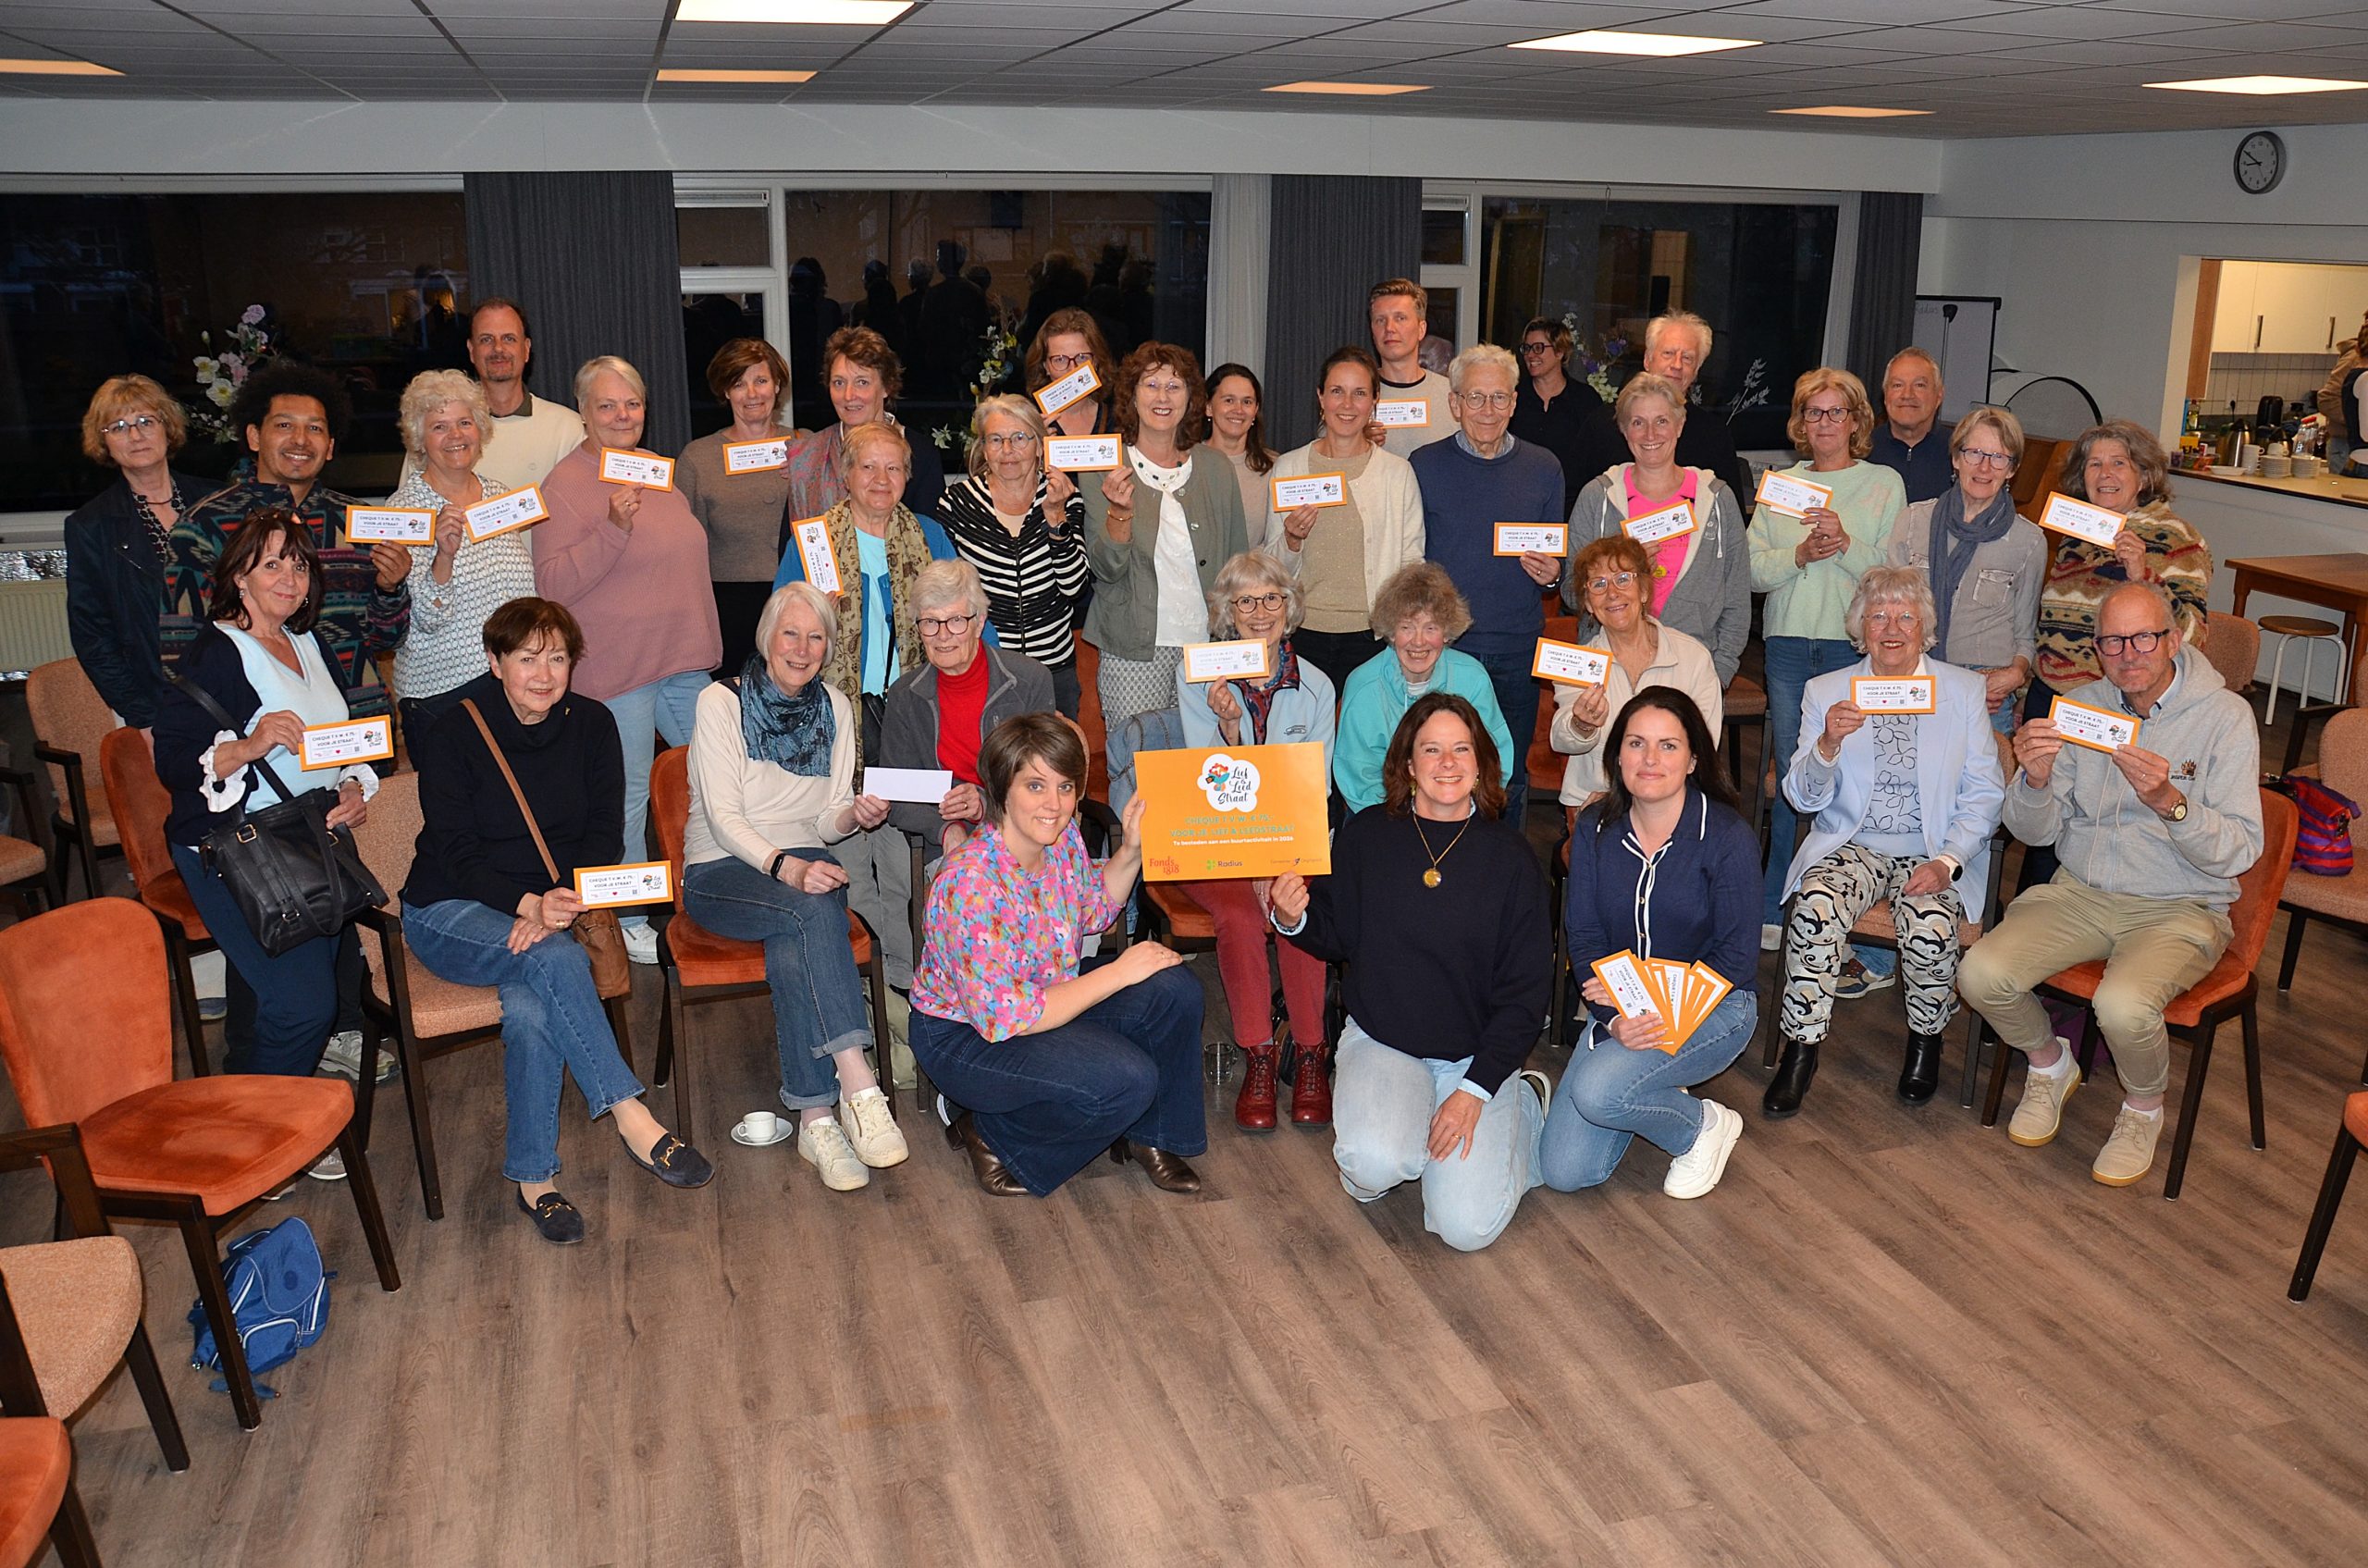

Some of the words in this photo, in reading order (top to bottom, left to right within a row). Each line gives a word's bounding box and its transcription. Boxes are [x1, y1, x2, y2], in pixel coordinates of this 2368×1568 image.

[2084, 721, 2100, 729] STRAAT
[1217, 792, 1248, 805] Straat
[1185, 816, 1219, 825] CHEQUE
[1170, 829, 1195, 837] VOOR
[1149, 856, 1175, 867] Fonds
[1163, 862, 1179, 875] 1818
